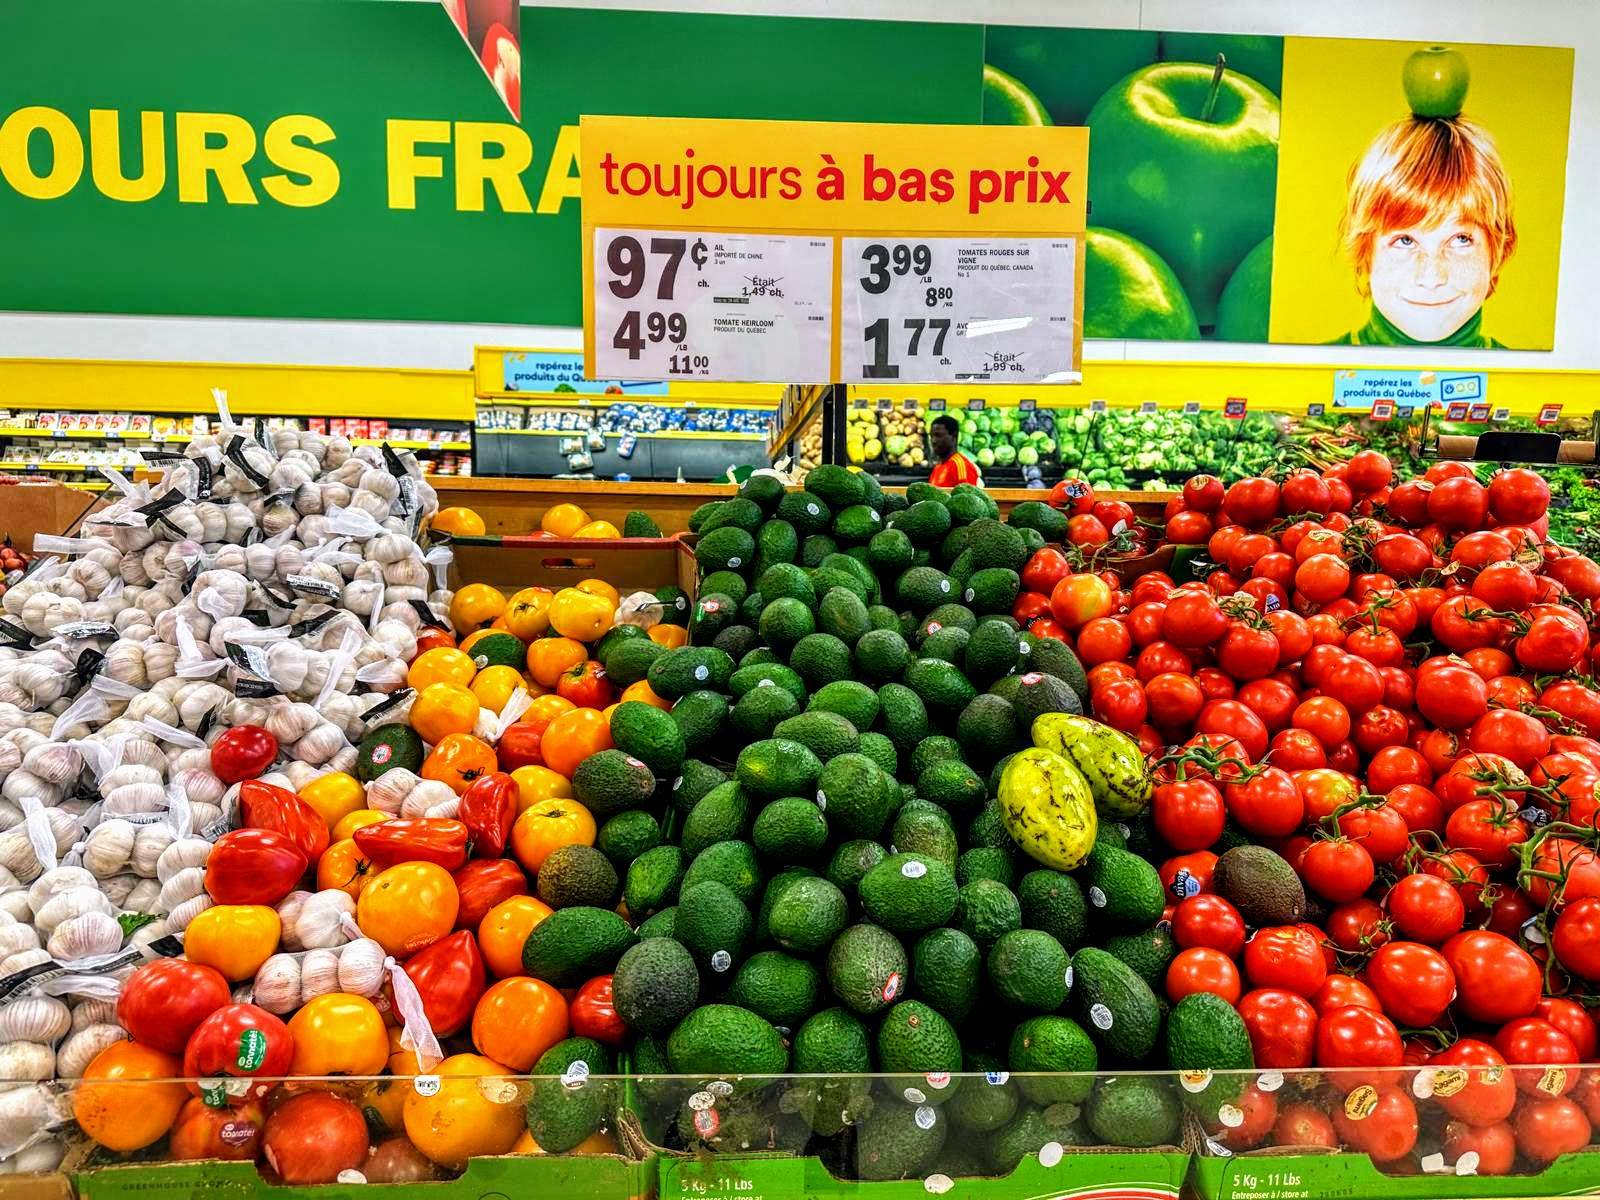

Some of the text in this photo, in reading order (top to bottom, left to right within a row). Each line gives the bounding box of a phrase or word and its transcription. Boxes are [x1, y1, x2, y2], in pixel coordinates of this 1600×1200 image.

[0, 106, 580, 214] OURS FRA
[599, 148, 1072, 214] toujours à bas prix
[697, 280, 710, 288] ch.
[752, 274, 775, 287] Était
[920, 277, 932, 285] /LB
[940, 357, 952, 365] ch.
[993, 350, 1016, 362] Était
[536, 362, 584, 371] repérez le
[514, 372, 555, 382] produits
[557, 372, 570, 381] du
[1364, 379, 1412, 388] repérez les
[1343, 389, 1432, 398] produits du Québec
[1233, 1174, 1240, 1187] 5
[1243, 1174, 1257, 1189] Kg
[1268, 1174, 1279, 1186] 11
[1283, 1172, 1301, 1186] Lbs
[681, 1180, 689, 1191] 5
[692, 1180, 706, 1194] Kg
[719, 1178, 730, 1191] 11
[734, 1179, 753, 1190] Lbs
[1232, 1191, 1269, 1200] Entreposer
[1281, 1191, 1299, 1199] store
[1300, 1190, 1309, 1198] at
